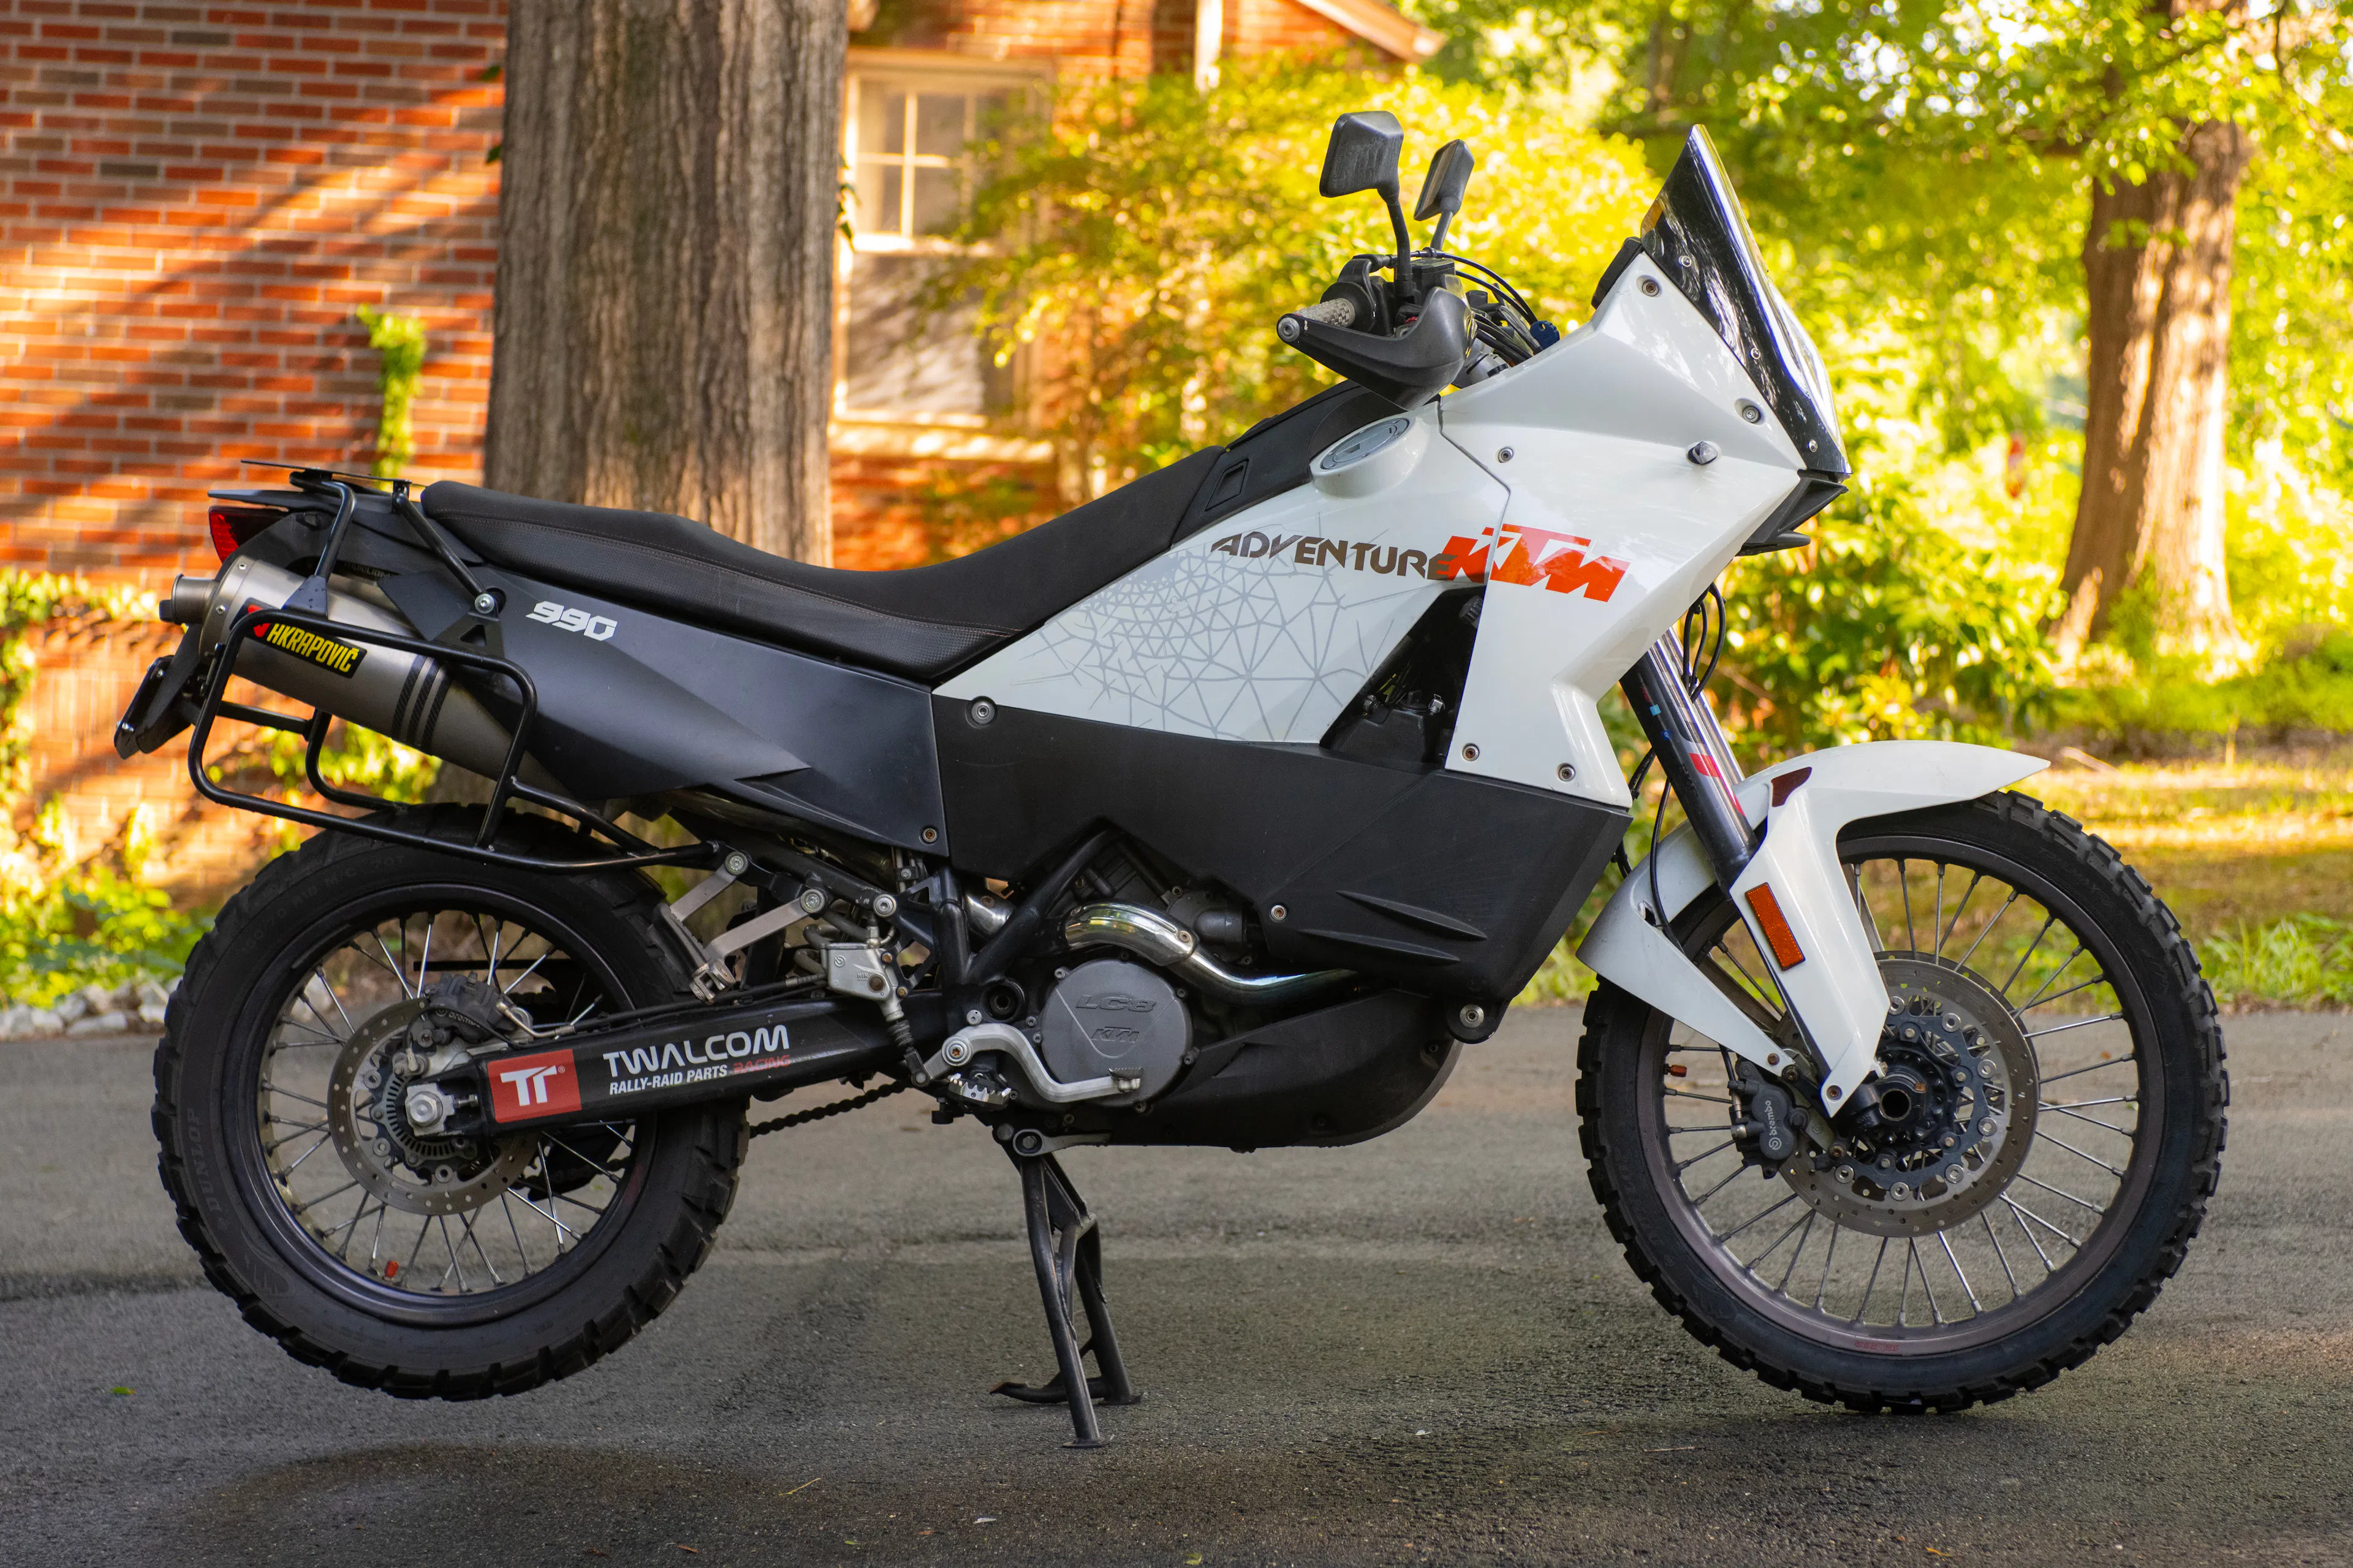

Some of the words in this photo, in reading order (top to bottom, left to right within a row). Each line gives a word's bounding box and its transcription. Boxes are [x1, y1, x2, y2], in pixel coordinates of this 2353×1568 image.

[1210, 531, 1458, 581] ADVENTURE
[1437, 523, 1631, 603] KTM
[526, 600, 618, 642] 990
[1075, 994, 1156, 1013] LC8
[602, 1024, 790, 1078] TWALCOM
[1091, 1026, 1140, 1043] KTM
[609, 1071, 683, 1096] RALLY-RAID
[686, 1064, 728, 1083] PARTS
[732, 1054, 791, 1074] RACING
[1764, 1100, 1778, 1136] brembo
[186, 1107, 222, 1213] DUNLOP
